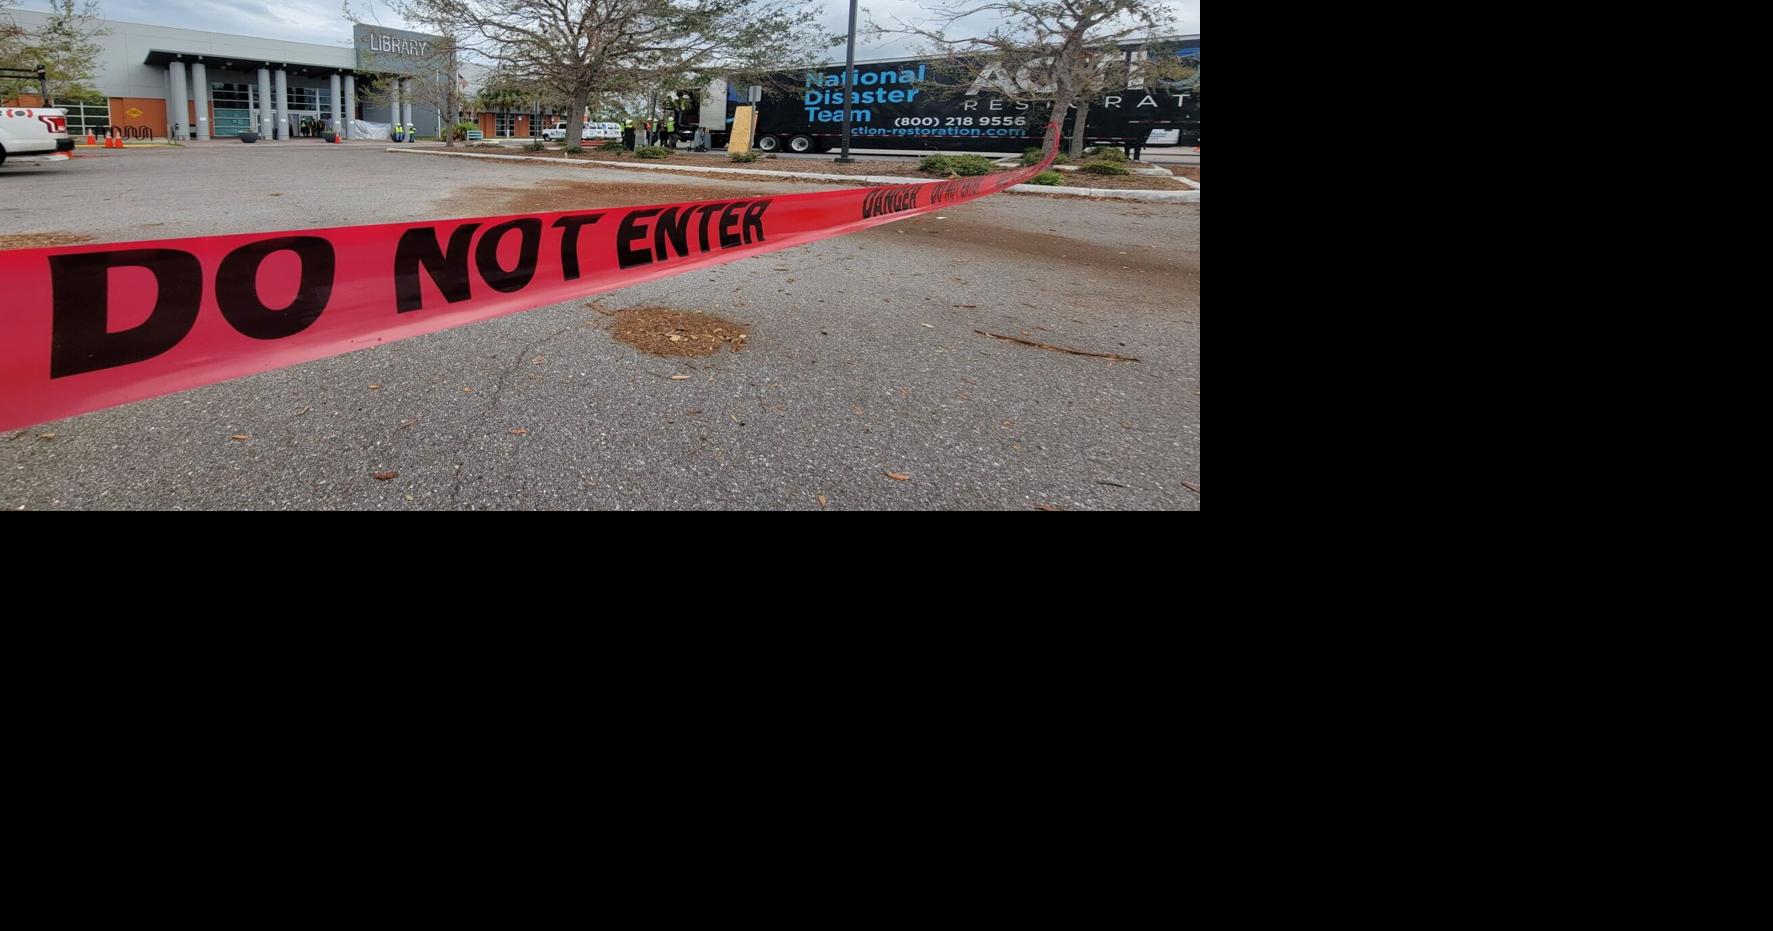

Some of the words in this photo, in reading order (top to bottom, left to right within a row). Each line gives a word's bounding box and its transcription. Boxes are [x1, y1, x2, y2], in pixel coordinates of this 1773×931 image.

[370, 33, 427, 57] LIBRARY
[964, 94, 1191, 111] RESRAT
[804, 106, 872, 122] Team
[894, 117, 940, 128] (800)
[945, 117, 973, 126] 218
[979, 116, 1026, 126] 9556
[851, 126, 1026, 137] ction-restoration.com
[862, 184, 921, 219] DANGER
[48, 235, 336, 380] DO
[394, 213, 605, 314] NOT
[616, 200, 774, 270] ENTER
